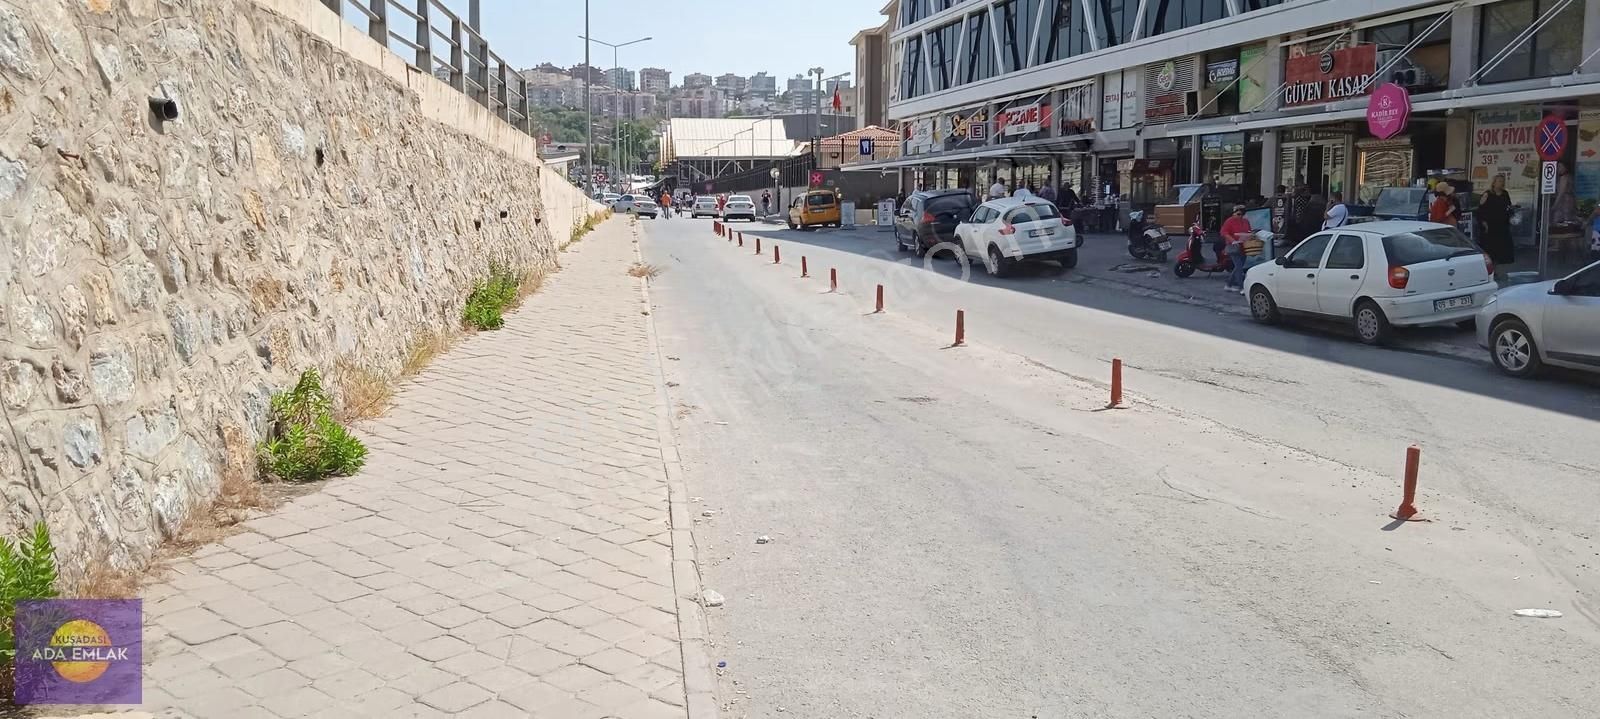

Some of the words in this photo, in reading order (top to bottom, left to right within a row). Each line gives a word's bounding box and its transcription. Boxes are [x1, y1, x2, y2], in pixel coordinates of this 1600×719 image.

[1285, 80, 1322, 104] GÜVEN
[1329, 74, 1369, 98] KASAP
[1502, 123, 1533, 144] FİYAT
